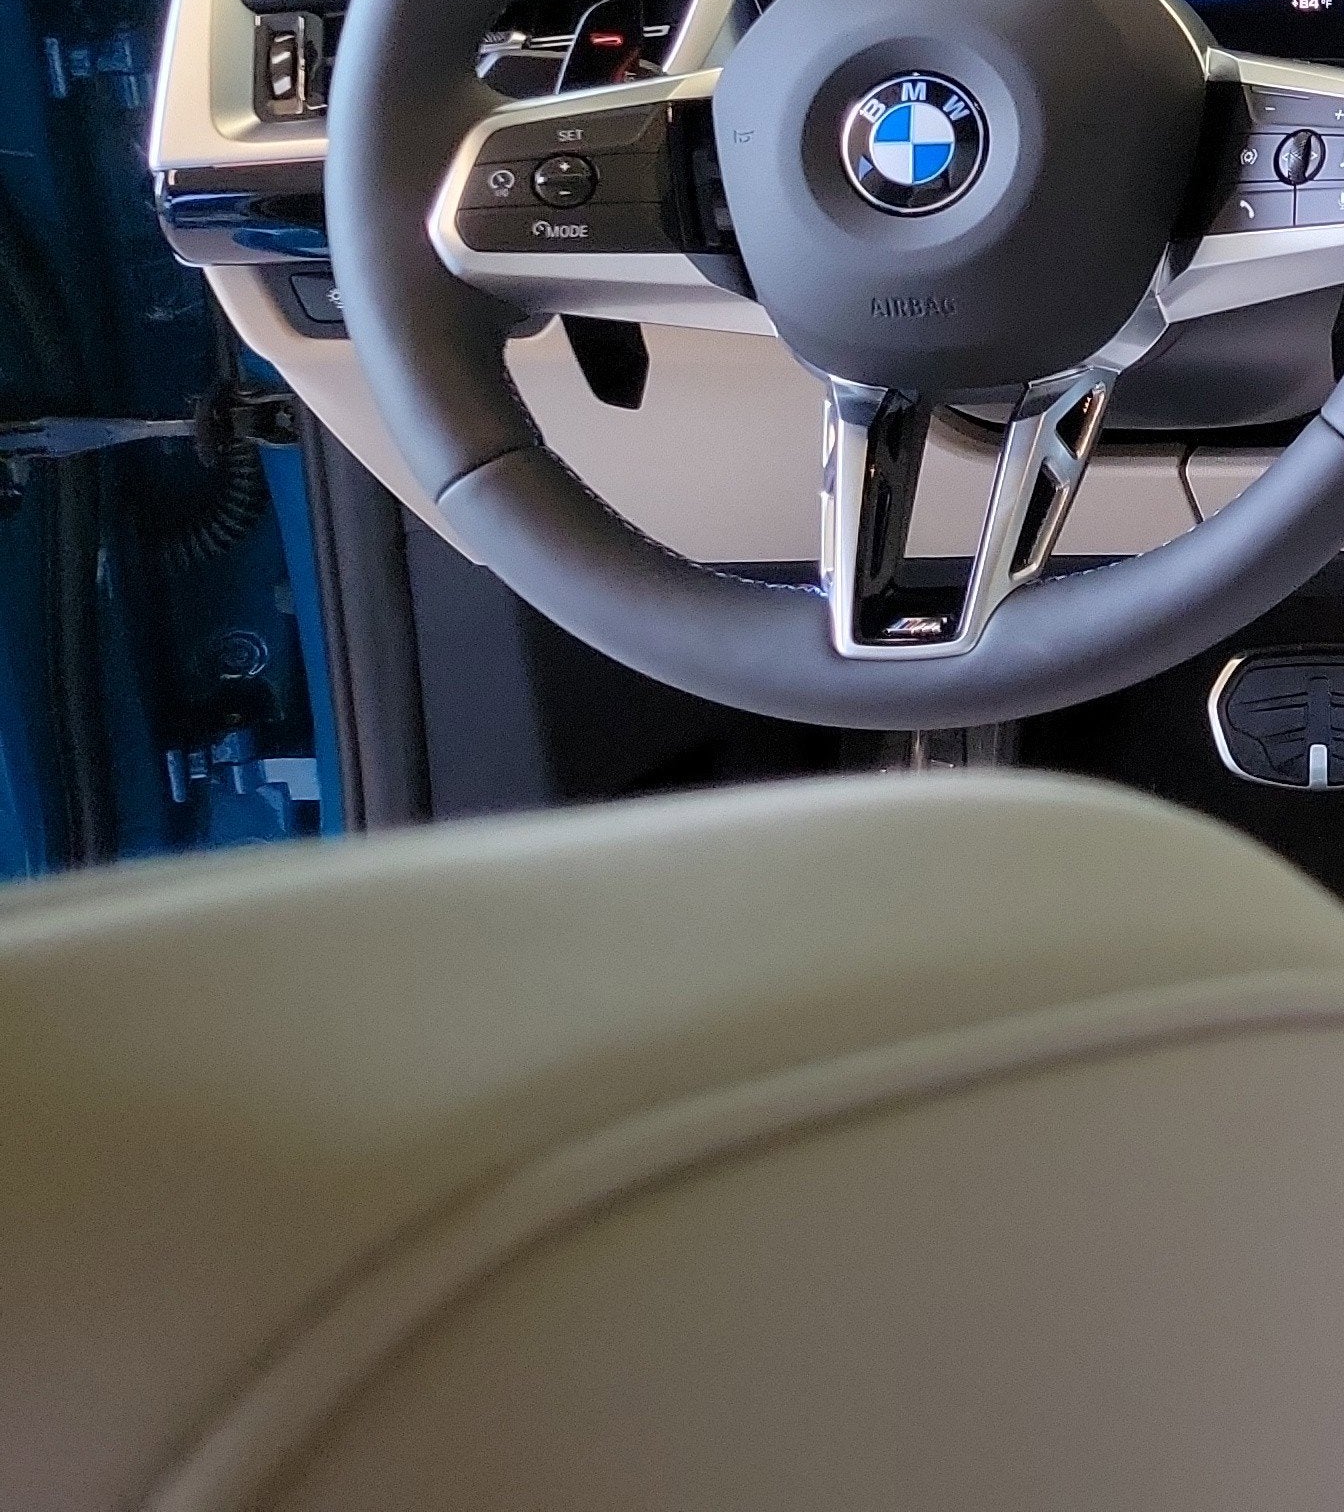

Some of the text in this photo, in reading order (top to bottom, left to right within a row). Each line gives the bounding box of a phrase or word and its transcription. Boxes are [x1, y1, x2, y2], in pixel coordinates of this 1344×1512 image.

[860, 82, 971, 124] BMW
[559, 129, 584, 142] SET
[546, 225, 589, 238] MODE
[871, 297, 958, 318] AIRBAG
